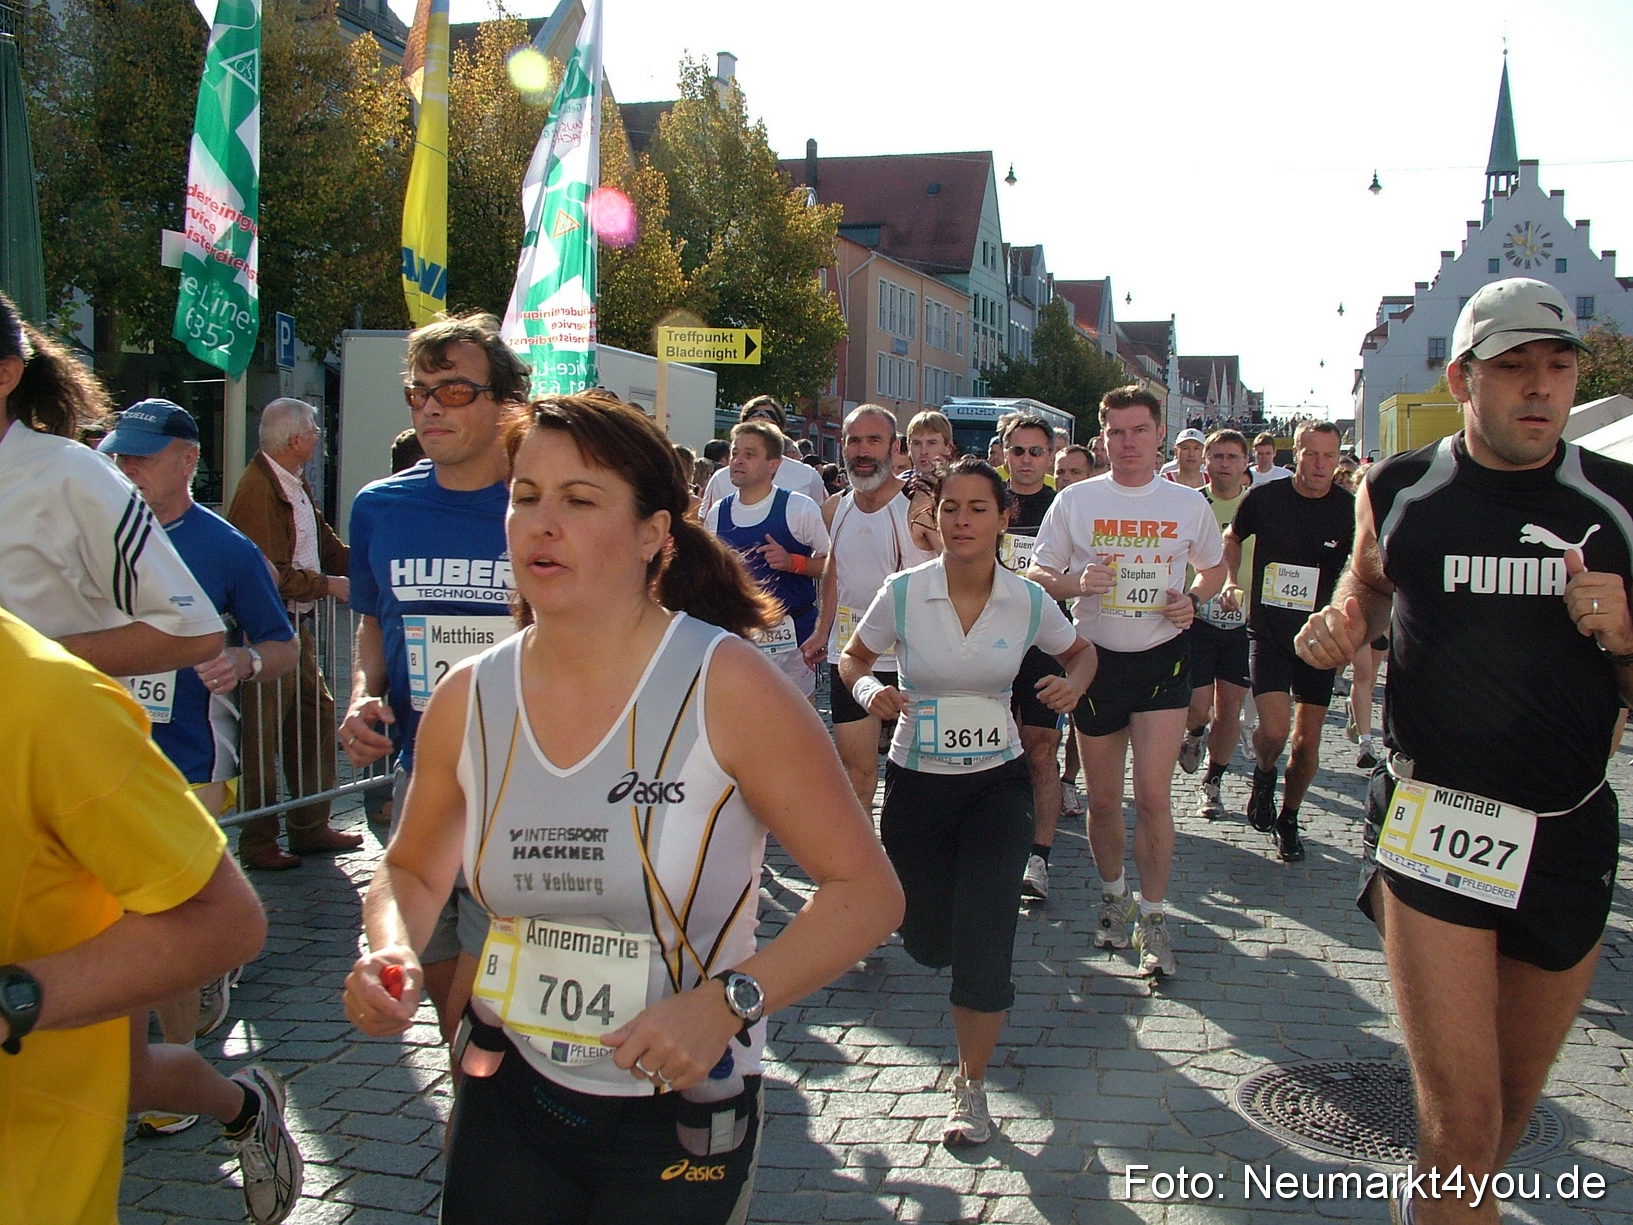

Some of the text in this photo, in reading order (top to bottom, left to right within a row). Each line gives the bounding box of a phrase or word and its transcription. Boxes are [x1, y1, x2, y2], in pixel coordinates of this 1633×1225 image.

[280, 321, 291, 358] P
[667, 331, 734, 345] Treffpunkt
[666, 346, 737, 361] Bladenight
[1093, 519, 1178, 539] MERZ
[1090, 531, 1160, 548] Reisen
[390, 558, 518, 588] HUBER
[1121, 567, 1156, 581] Stephan
[1278, 567, 1300, 579] Ulrich
[1444, 555, 1568, 597] PUMA
[1126, 588, 1158, 604] 407
[1281, 584, 1308, 599] 484
[1212, 610, 1242, 621] 3249
[431, 625, 494, 644] Matthias
[410, 653, 417, 666] B
[944, 727, 1000, 748] 3614
[525, 828, 609, 842] INTERSPORT
[1395, 806, 1405, 821] B
[1429, 824, 1519, 871] 1027
[512, 846, 605, 861] HACKNER
[513, 873, 534, 892] TV
[1462, 877, 1516, 899] PFLEIDERER
[526, 919, 639, 959] Annemarie
[486, 954, 615, 1026] B 704
[570, 1043, 613, 1060] PFLEID
